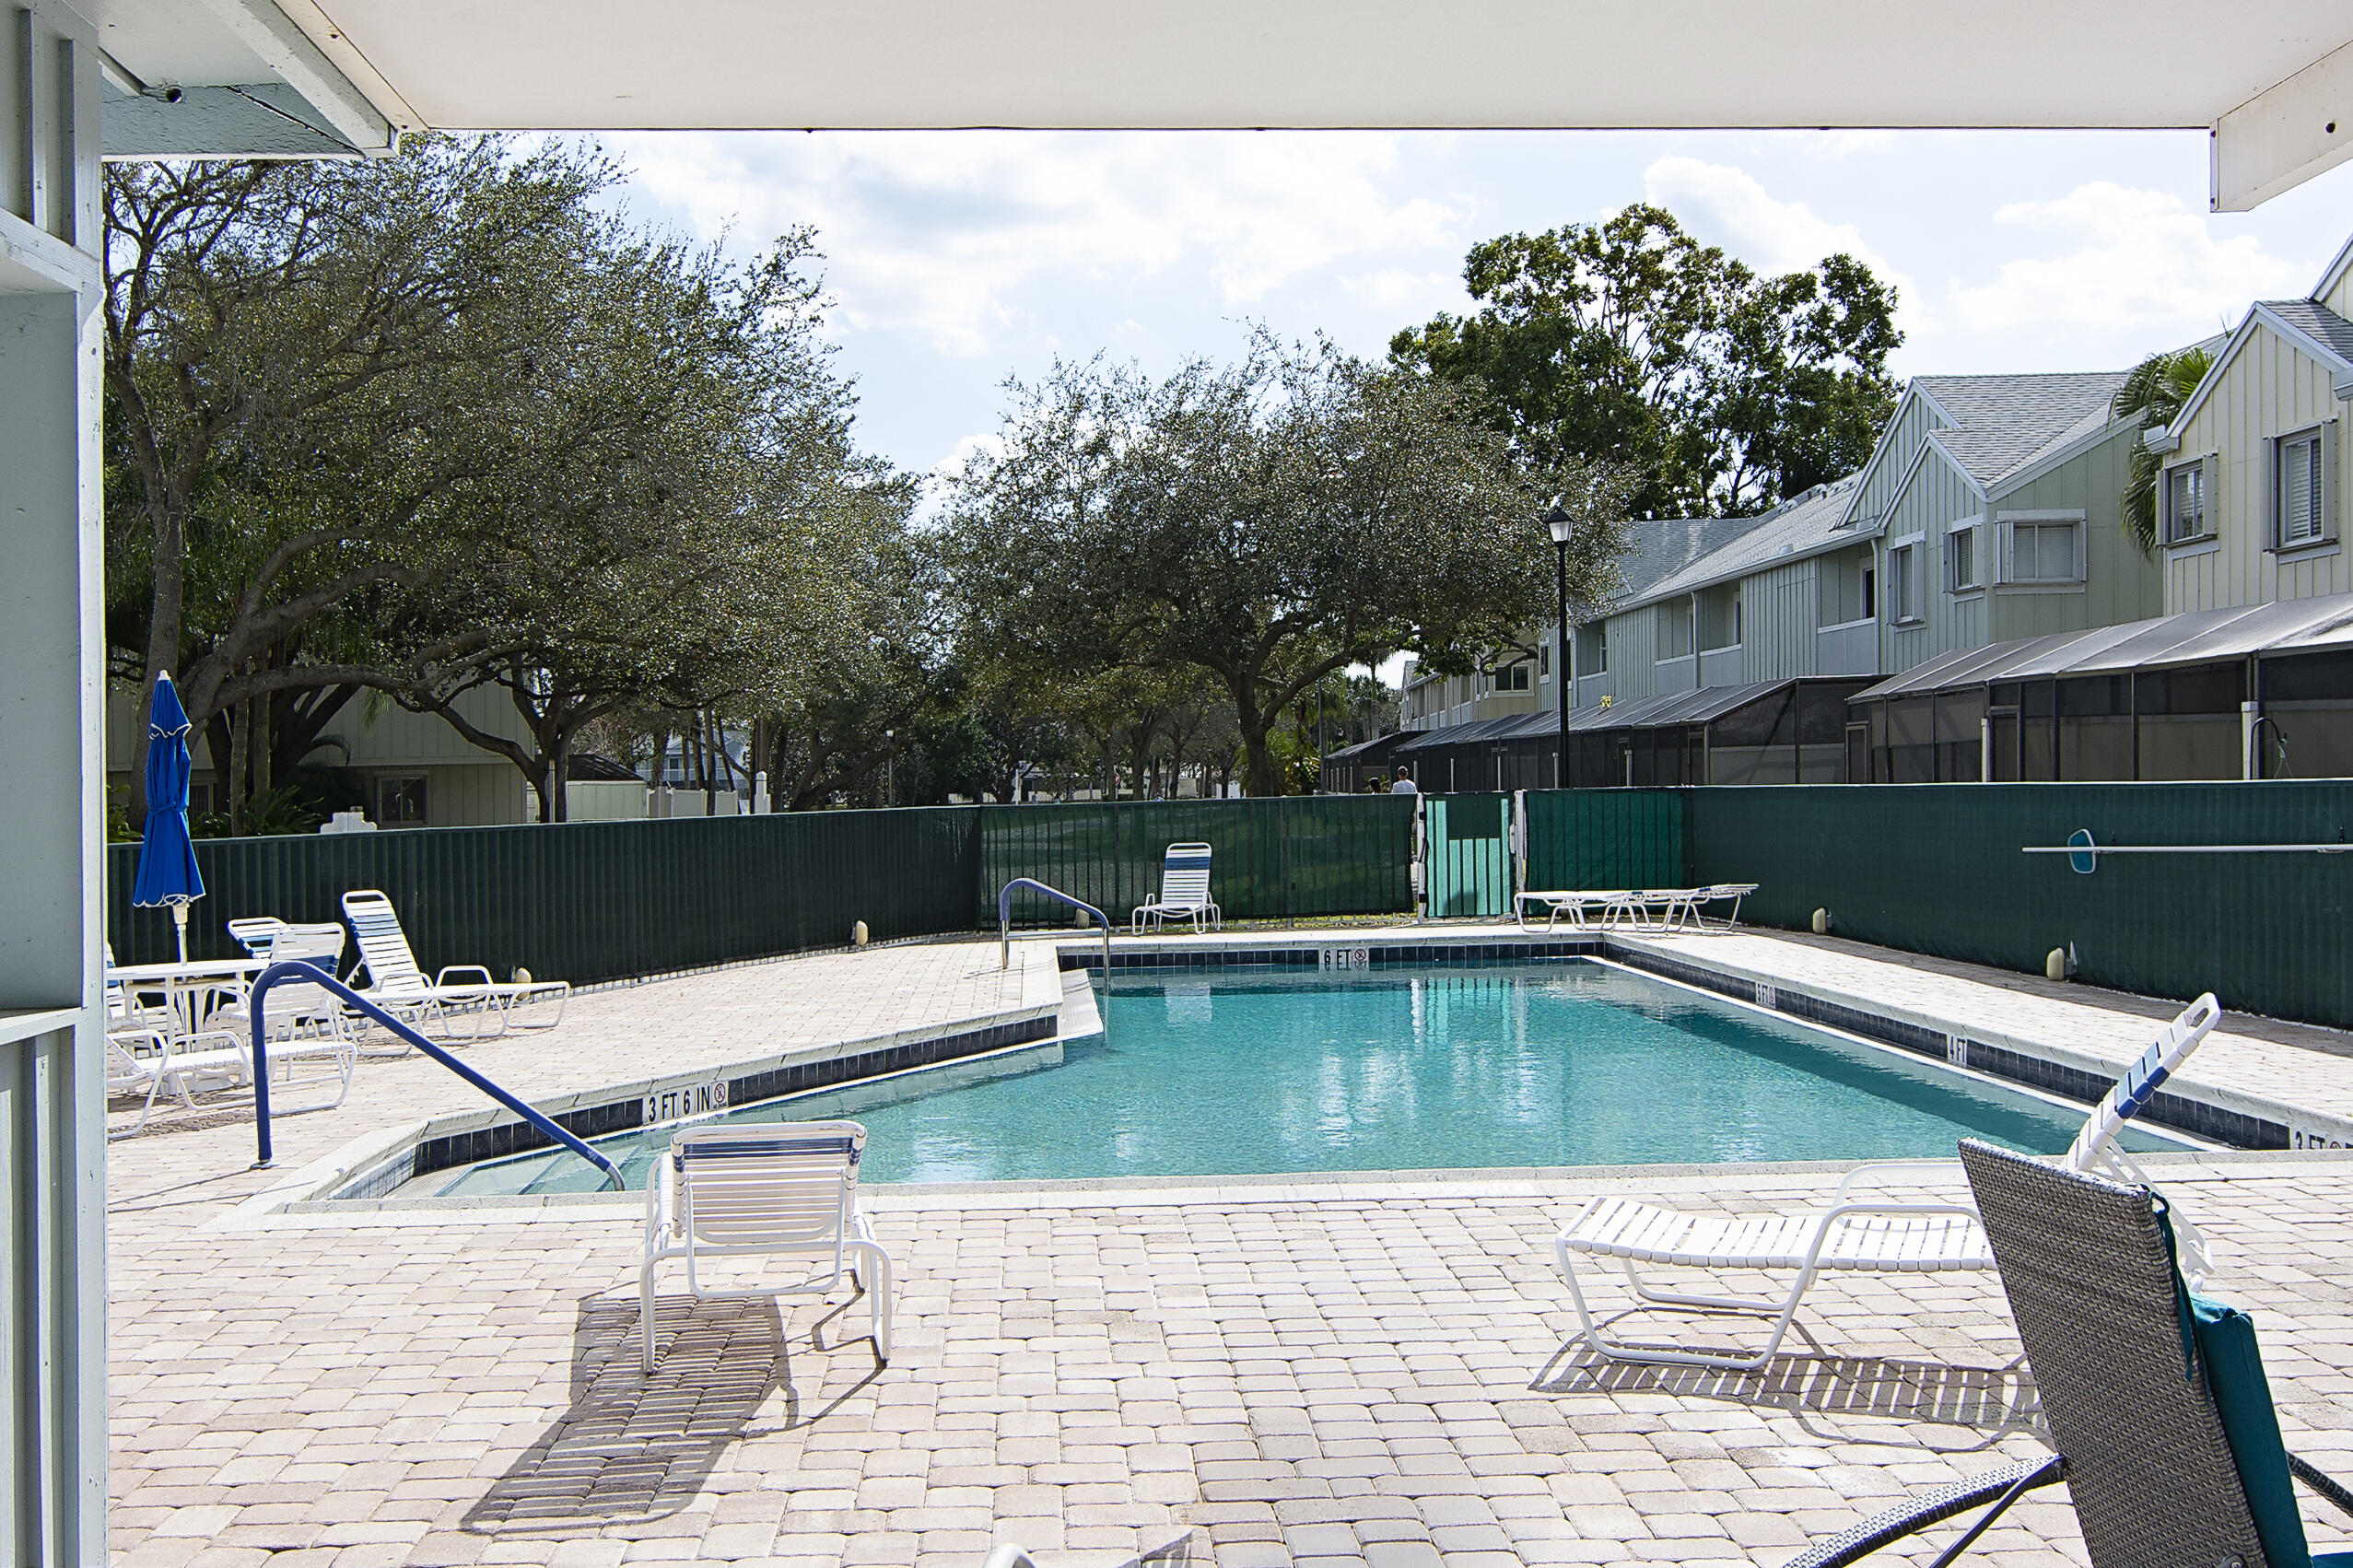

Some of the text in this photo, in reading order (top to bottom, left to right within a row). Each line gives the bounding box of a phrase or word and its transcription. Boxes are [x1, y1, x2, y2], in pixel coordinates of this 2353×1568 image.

[1949, 1036, 1966, 1063] 4 FT
[649, 1085, 710, 1122] 3 FT 6 IN
